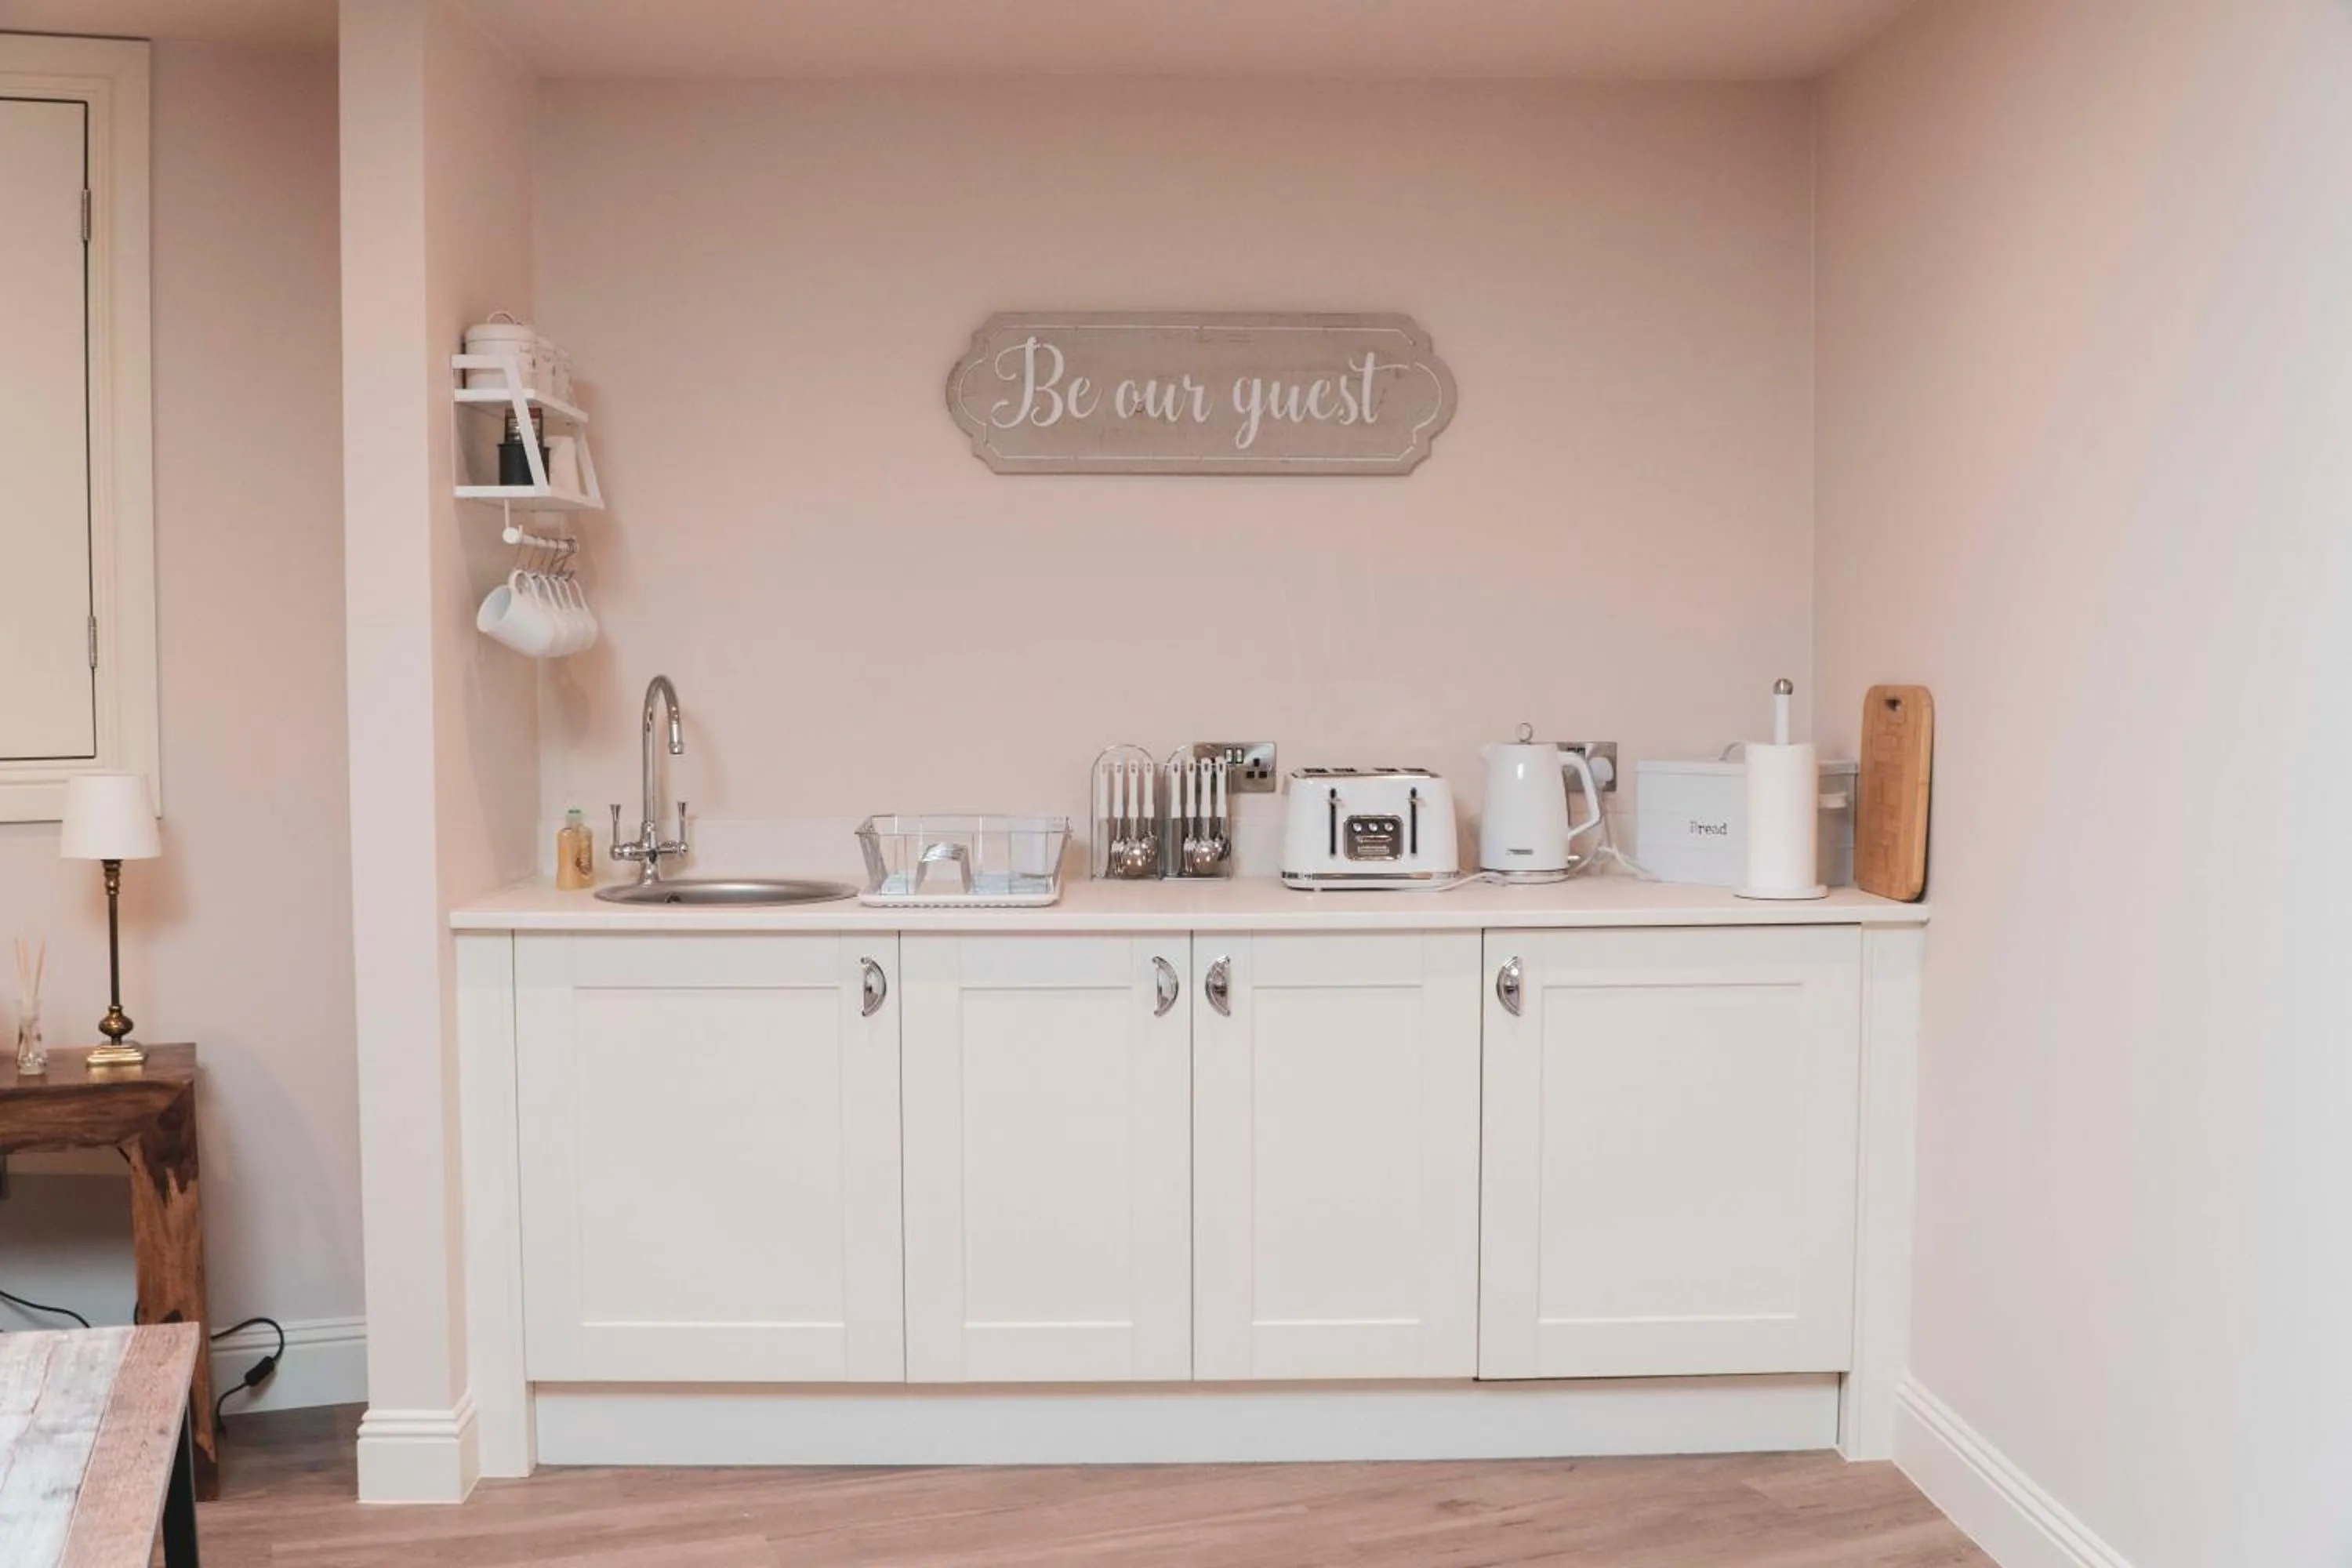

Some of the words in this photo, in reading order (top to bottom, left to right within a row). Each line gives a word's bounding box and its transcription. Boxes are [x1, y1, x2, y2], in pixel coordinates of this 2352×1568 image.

[991, 336, 1096, 428] Be
[1115, 375, 1213, 423] our
[1232, 351, 1409, 449] guest
